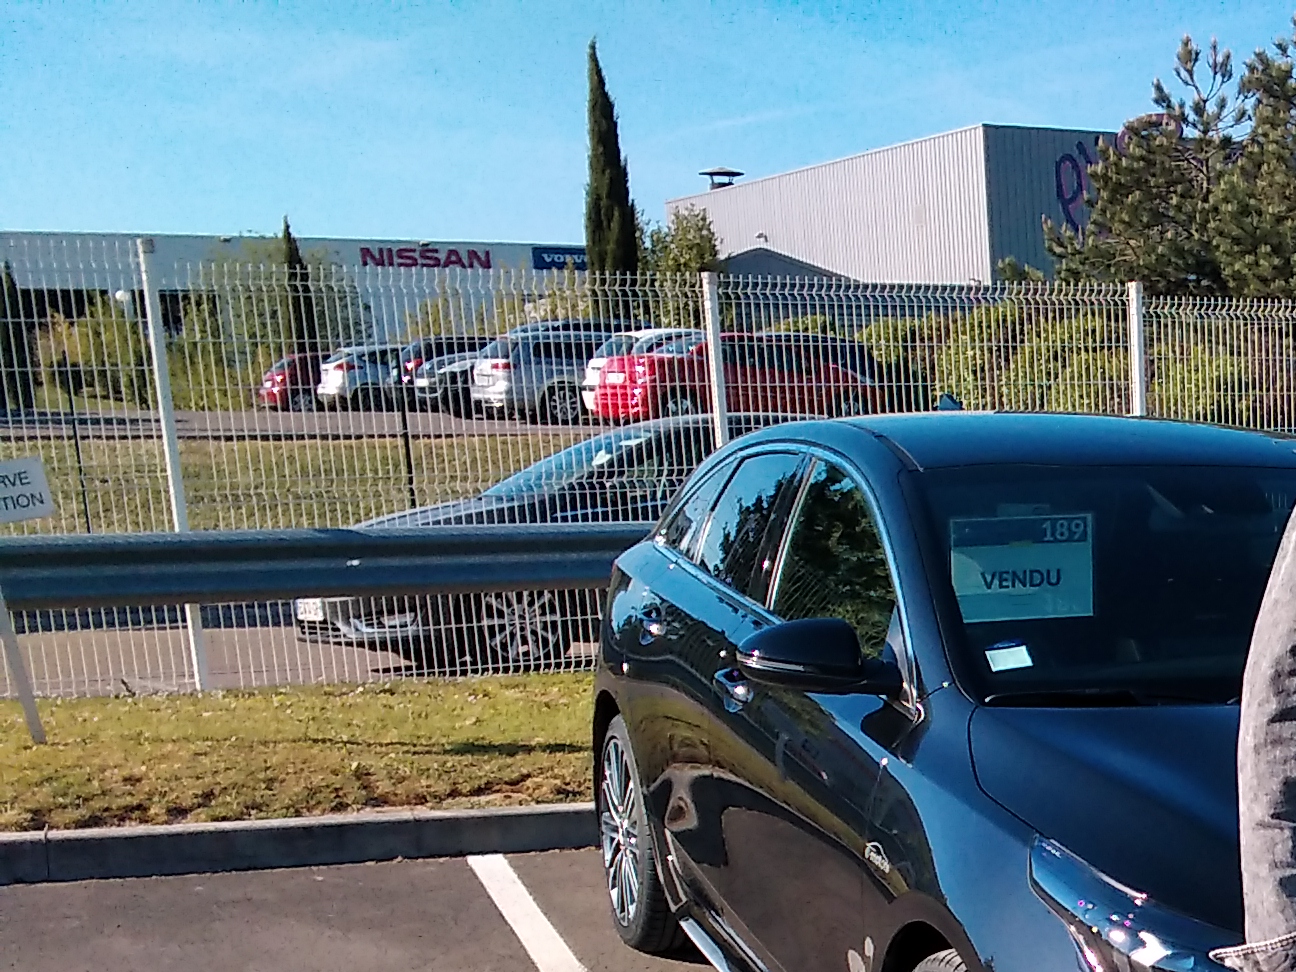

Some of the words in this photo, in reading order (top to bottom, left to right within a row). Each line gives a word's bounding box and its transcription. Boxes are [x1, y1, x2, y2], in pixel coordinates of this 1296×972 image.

[360, 247, 492, 269] NISSAN
[0, 492, 45, 511] TION
[1041, 519, 1084, 541] 189
[980, 568, 1061, 590] VENDU
